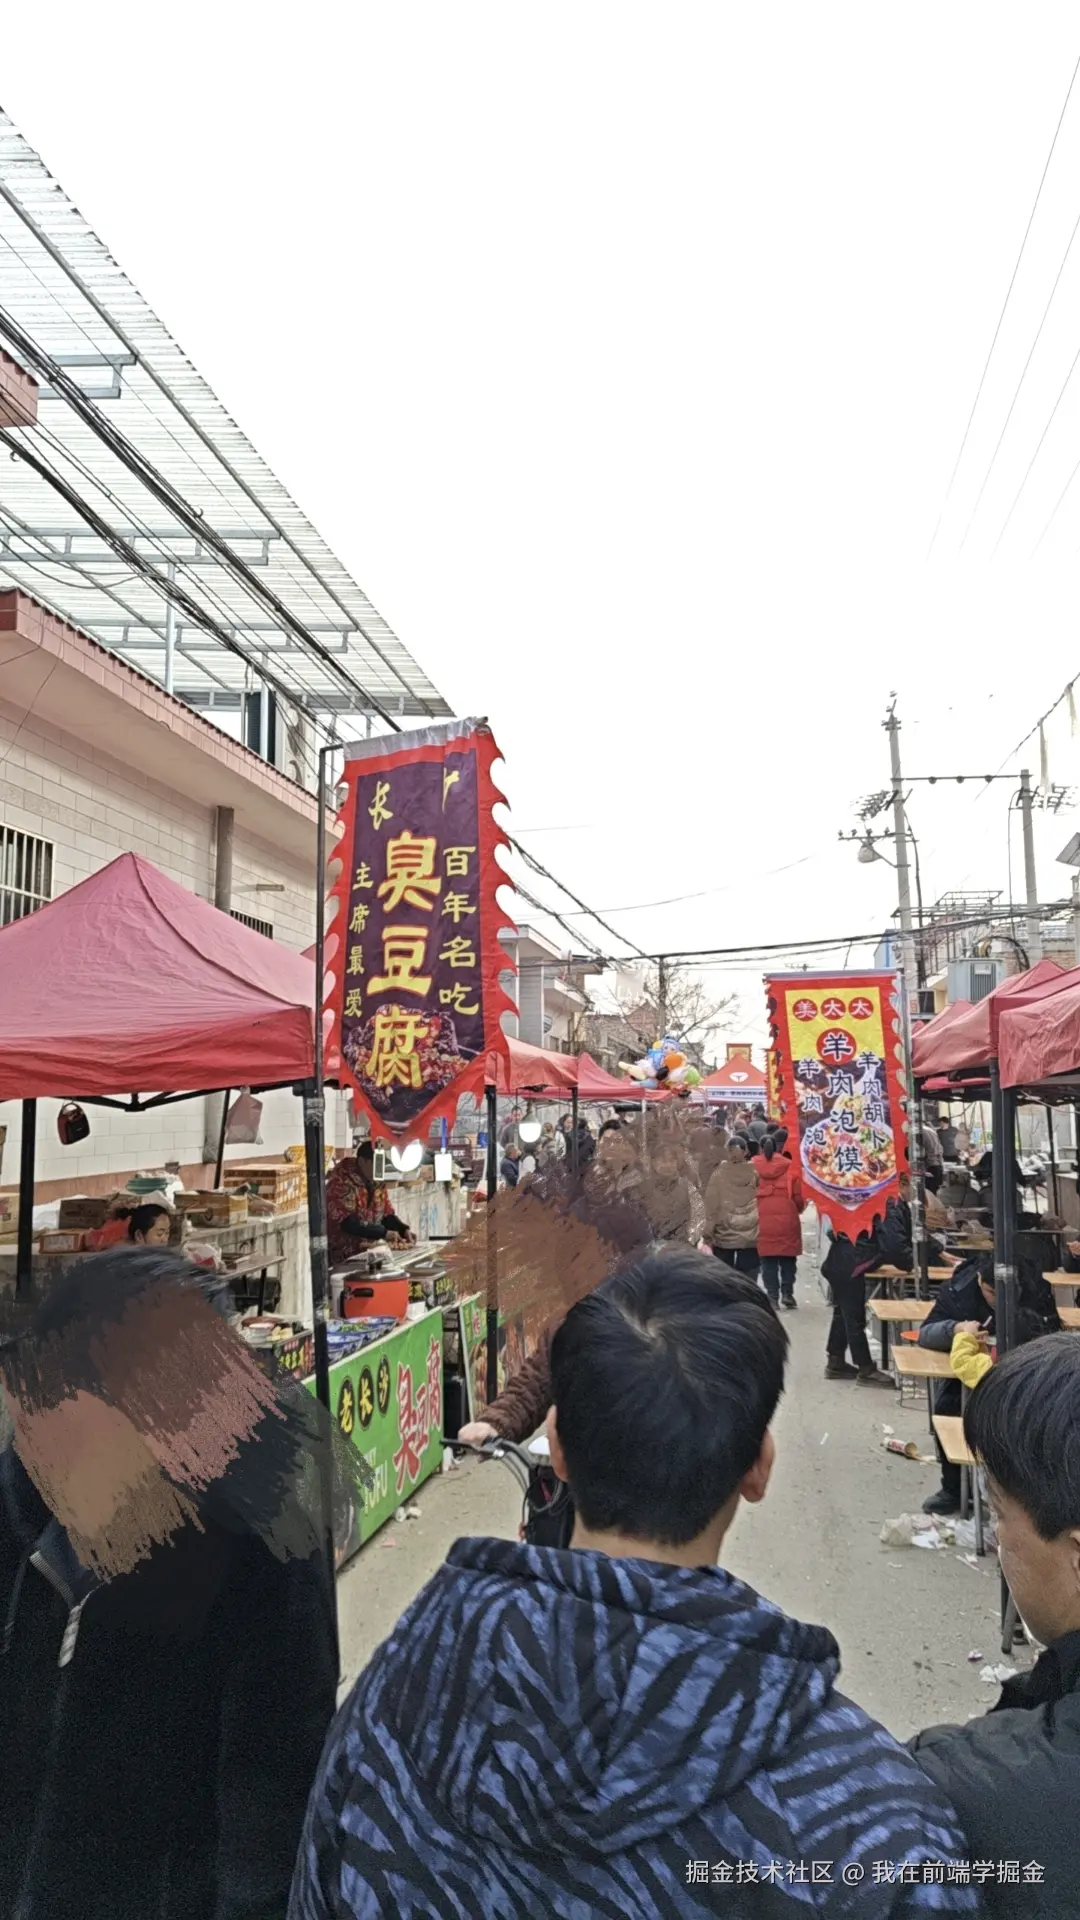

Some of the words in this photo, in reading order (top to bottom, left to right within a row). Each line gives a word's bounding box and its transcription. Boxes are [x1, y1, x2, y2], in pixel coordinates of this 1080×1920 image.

[344, 861, 374, 1018] 主席最爱
[367, 831, 441, 1088] 臭豆腐
[439, 846, 480, 1016] 百年名吃
[798, 1058, 827, 1146] 羊肉泡
[823, 1032, 863, 1173] 羊肉泡馍
[857, 1051, 886, 1149] 羊肉胡卜
[340, 1366, 388, 1433] 老长沙
[393, 1334, 442, 1496] 臭豆腐
